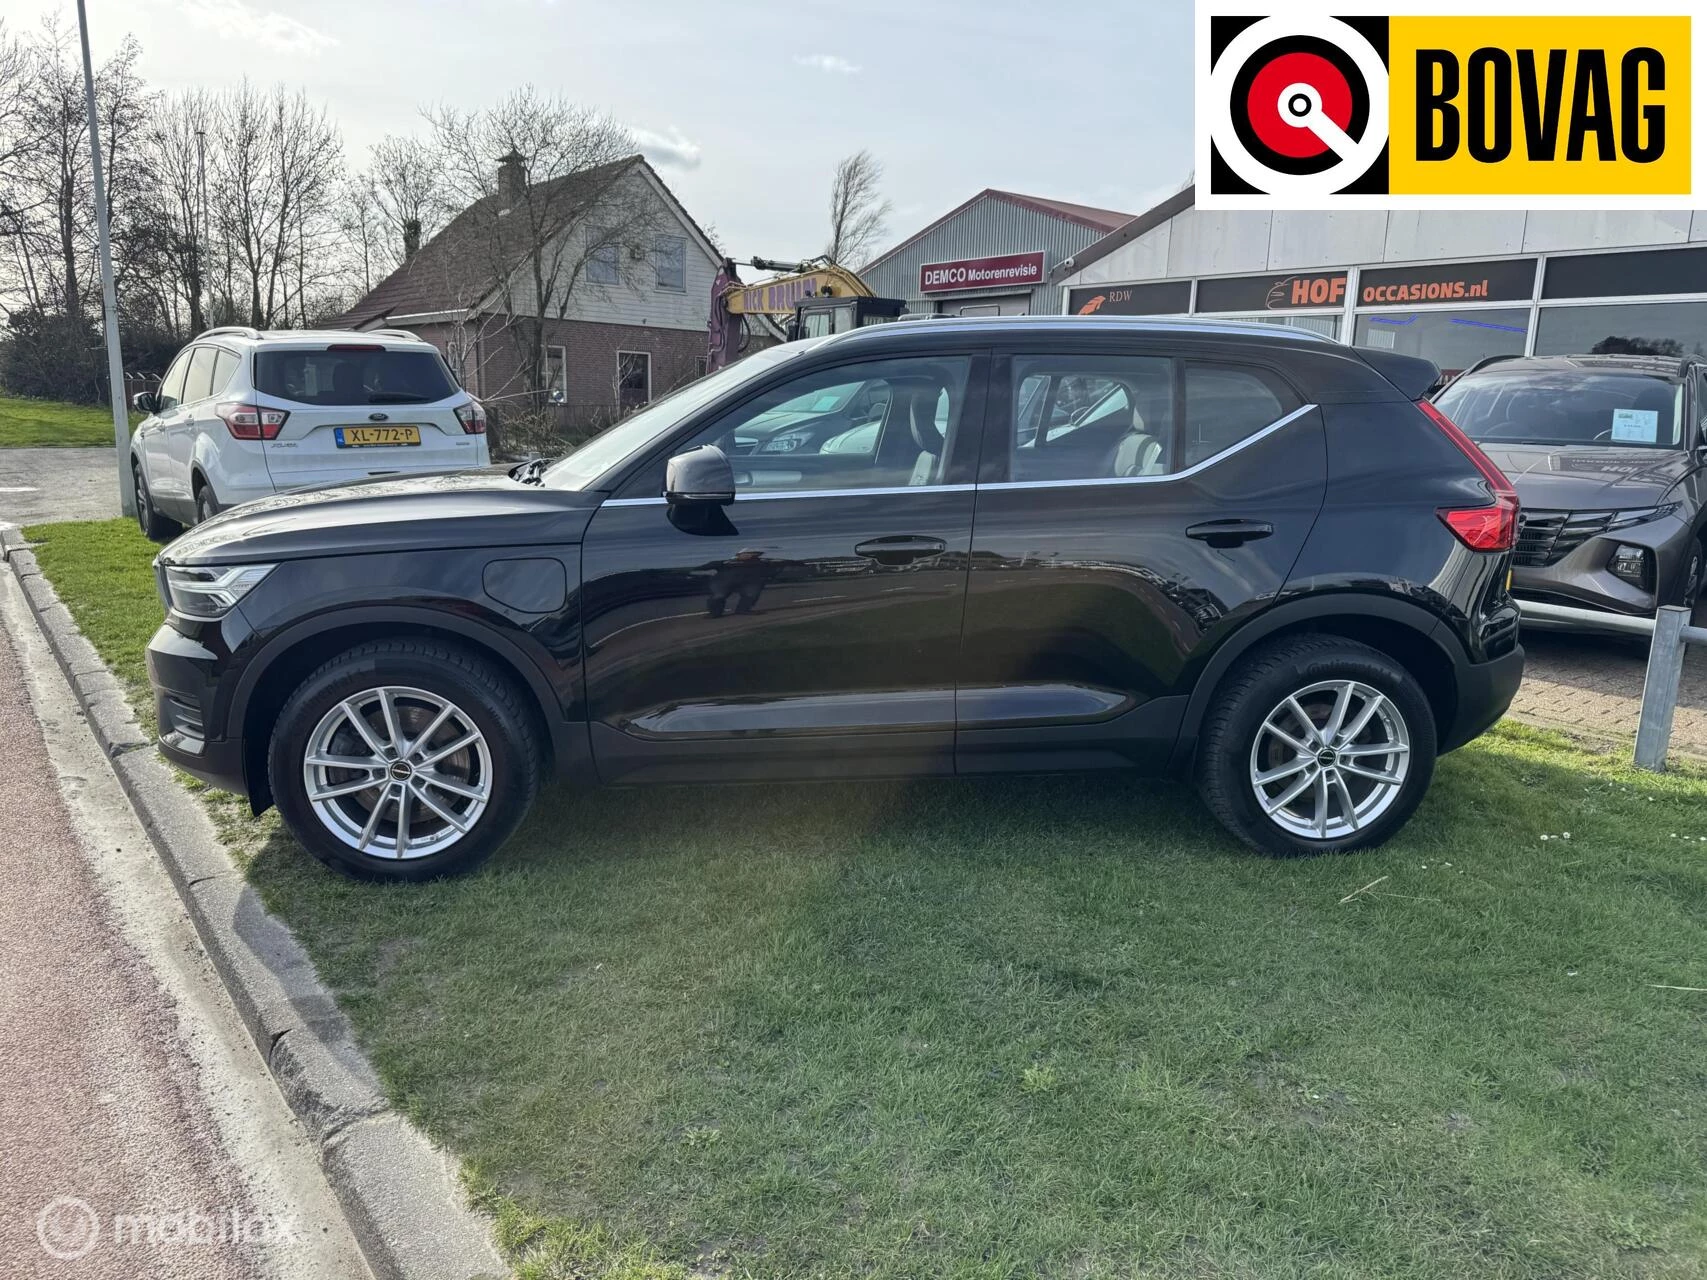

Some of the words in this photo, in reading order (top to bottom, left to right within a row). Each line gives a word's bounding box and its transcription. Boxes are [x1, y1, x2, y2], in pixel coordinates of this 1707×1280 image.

[925, 267, 967, 285] DEMCO
[968, 263, 1038, 281] Motorenrevisie
[1109, 290, 1133, 303] RDW
[1291, 277, 1347, 305] HOF
[1363, 279, 1489, 303] OCCASIONS.nl
[350, 428, 413, 442] XL-772-P
